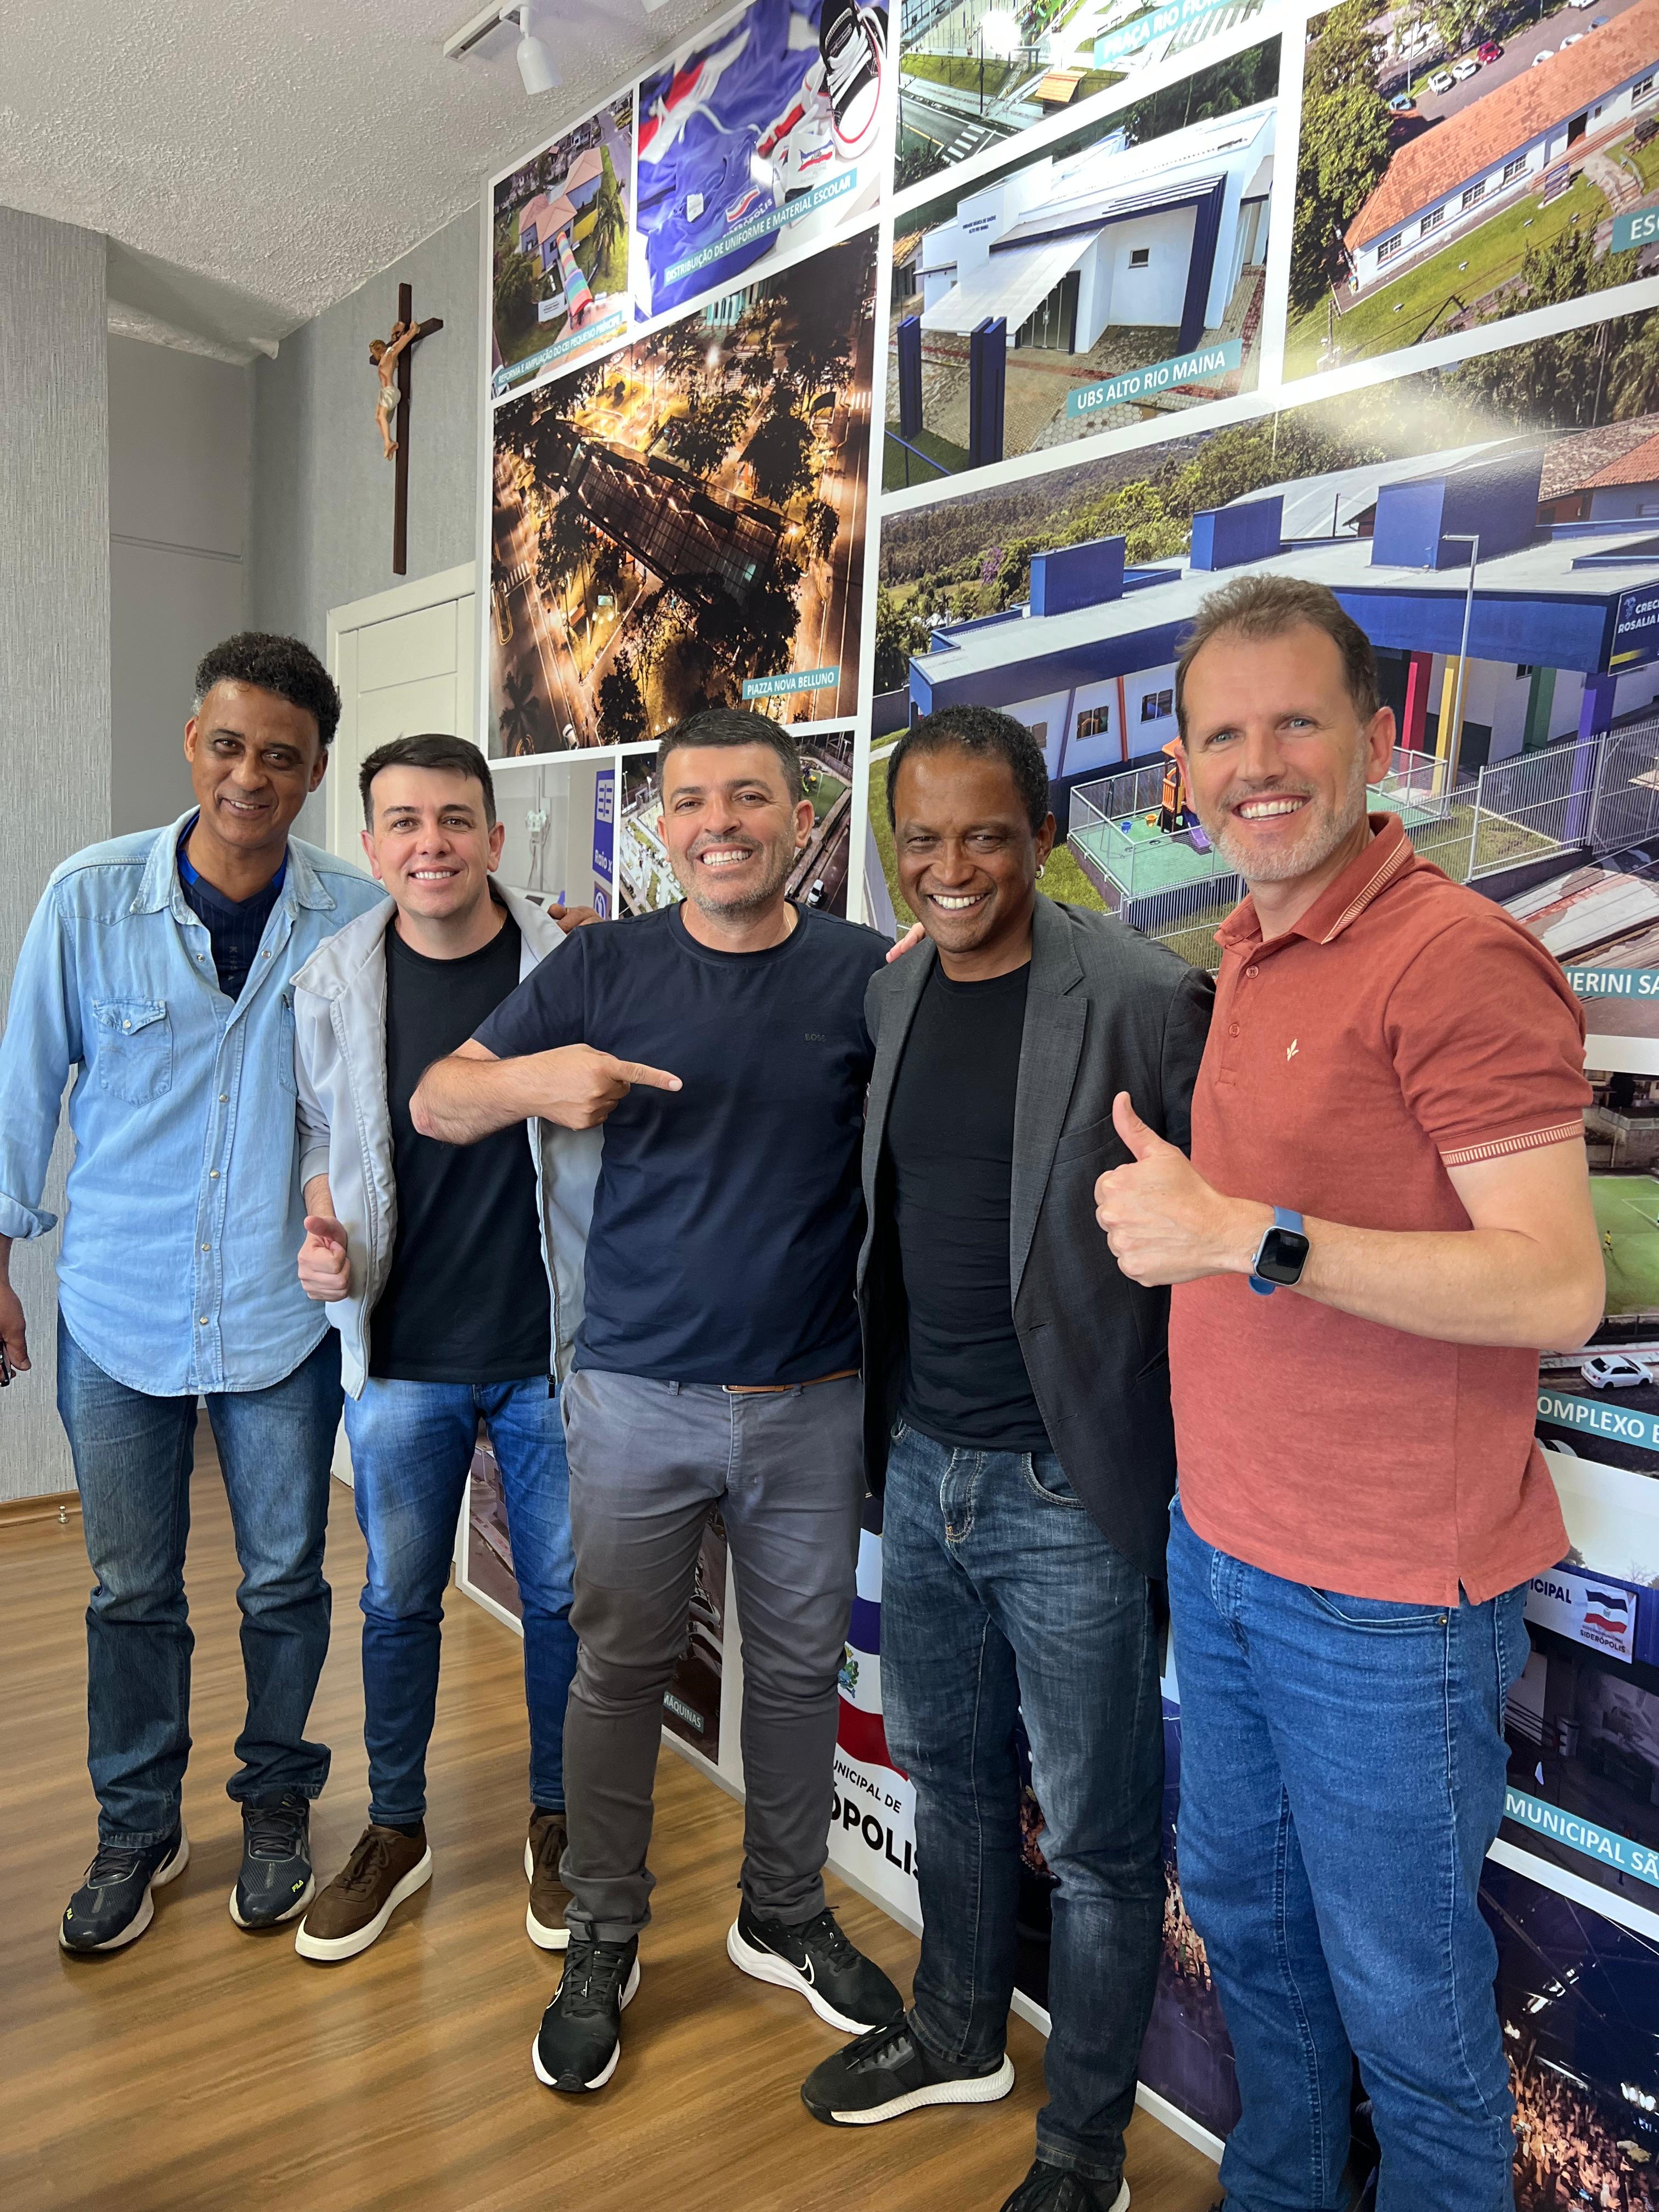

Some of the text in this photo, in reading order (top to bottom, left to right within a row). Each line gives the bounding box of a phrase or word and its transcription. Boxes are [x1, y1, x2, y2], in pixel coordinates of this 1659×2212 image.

[1153, 6, 1180, 34] RIO
[666, 249, 713, 282] DISTRIBUIÇÃO
[714, 242, 724, 257] DE
[725, 221, 764, 251] UNIFORME
[766, 217, 771, 230] E
[772, 196, 812, 227] MATERIAL
[814, 175, 851, 205] ESCOLAR
[1630, 214, 1659, 240] ES
[498, 368, 521, 383] REFORMA
[521, 362, 525, 373] E
[524, 348, 553, 370] AMPLIAÇÃO
[553, 346, 561, 357] DO
[570, 328, 595, 348] PEQUENO
[1077, 351, 1225, 409] UBS ALTO RIO MAINA
[1618, 614, 1656, 634] ROSALIA
[747, 672, 834, 696] PIAZZA NOVA BELLUNO
[595, 849, 607, 870] Raio
[1580, 1629, 1626, 1653] SIDERÓPOLIS
[885, 1793, 902, 1814] DE
[831, 1781, 918, 1881] POLI
[1505, 1793, 1659, 1881] MUNICIPAL SÃ
[292, 1880, 303, 1892] FILA
